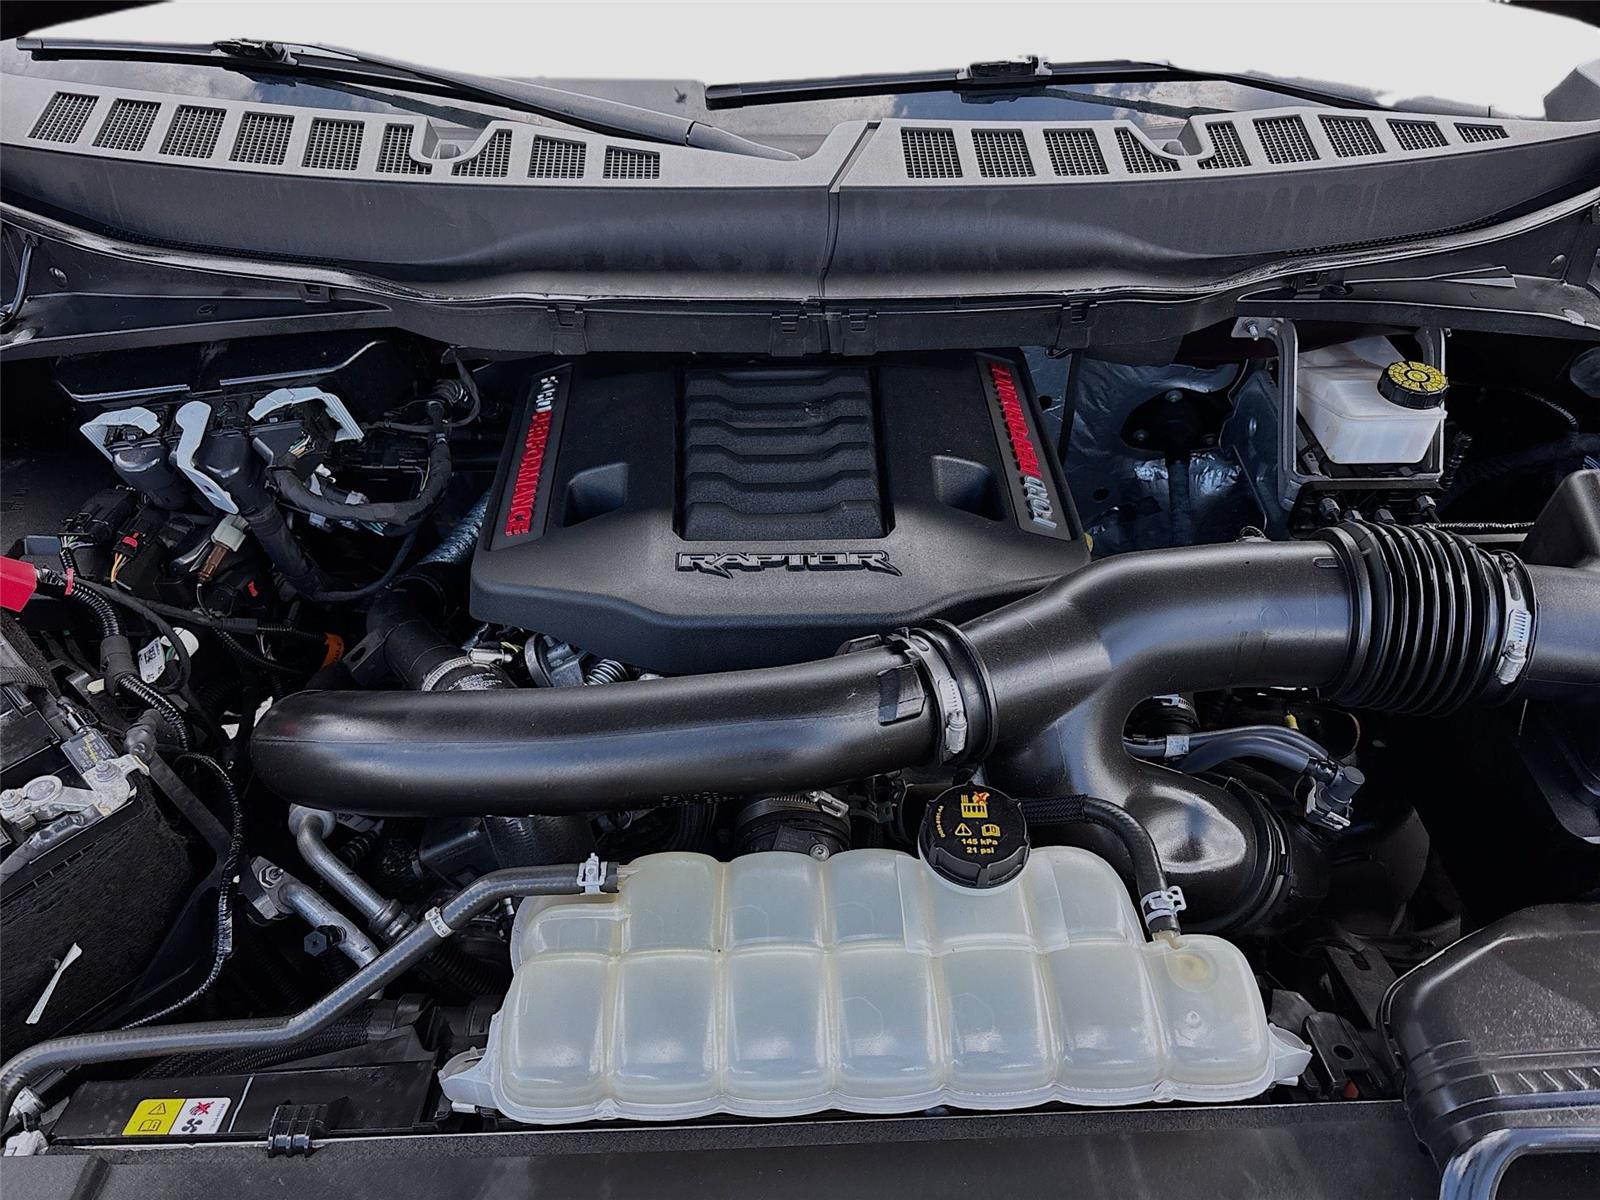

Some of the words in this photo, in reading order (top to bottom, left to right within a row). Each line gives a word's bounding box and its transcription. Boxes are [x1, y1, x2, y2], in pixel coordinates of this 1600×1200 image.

[989, 362, 1042, 478] PERFORMANCE
[505, 411, 552, 536] PERFORMANCE
[1023, 475, 1057, 529] FORD
[675, 551, 902, 579] RAPTOR
[980, 846, 994, 855] psi
